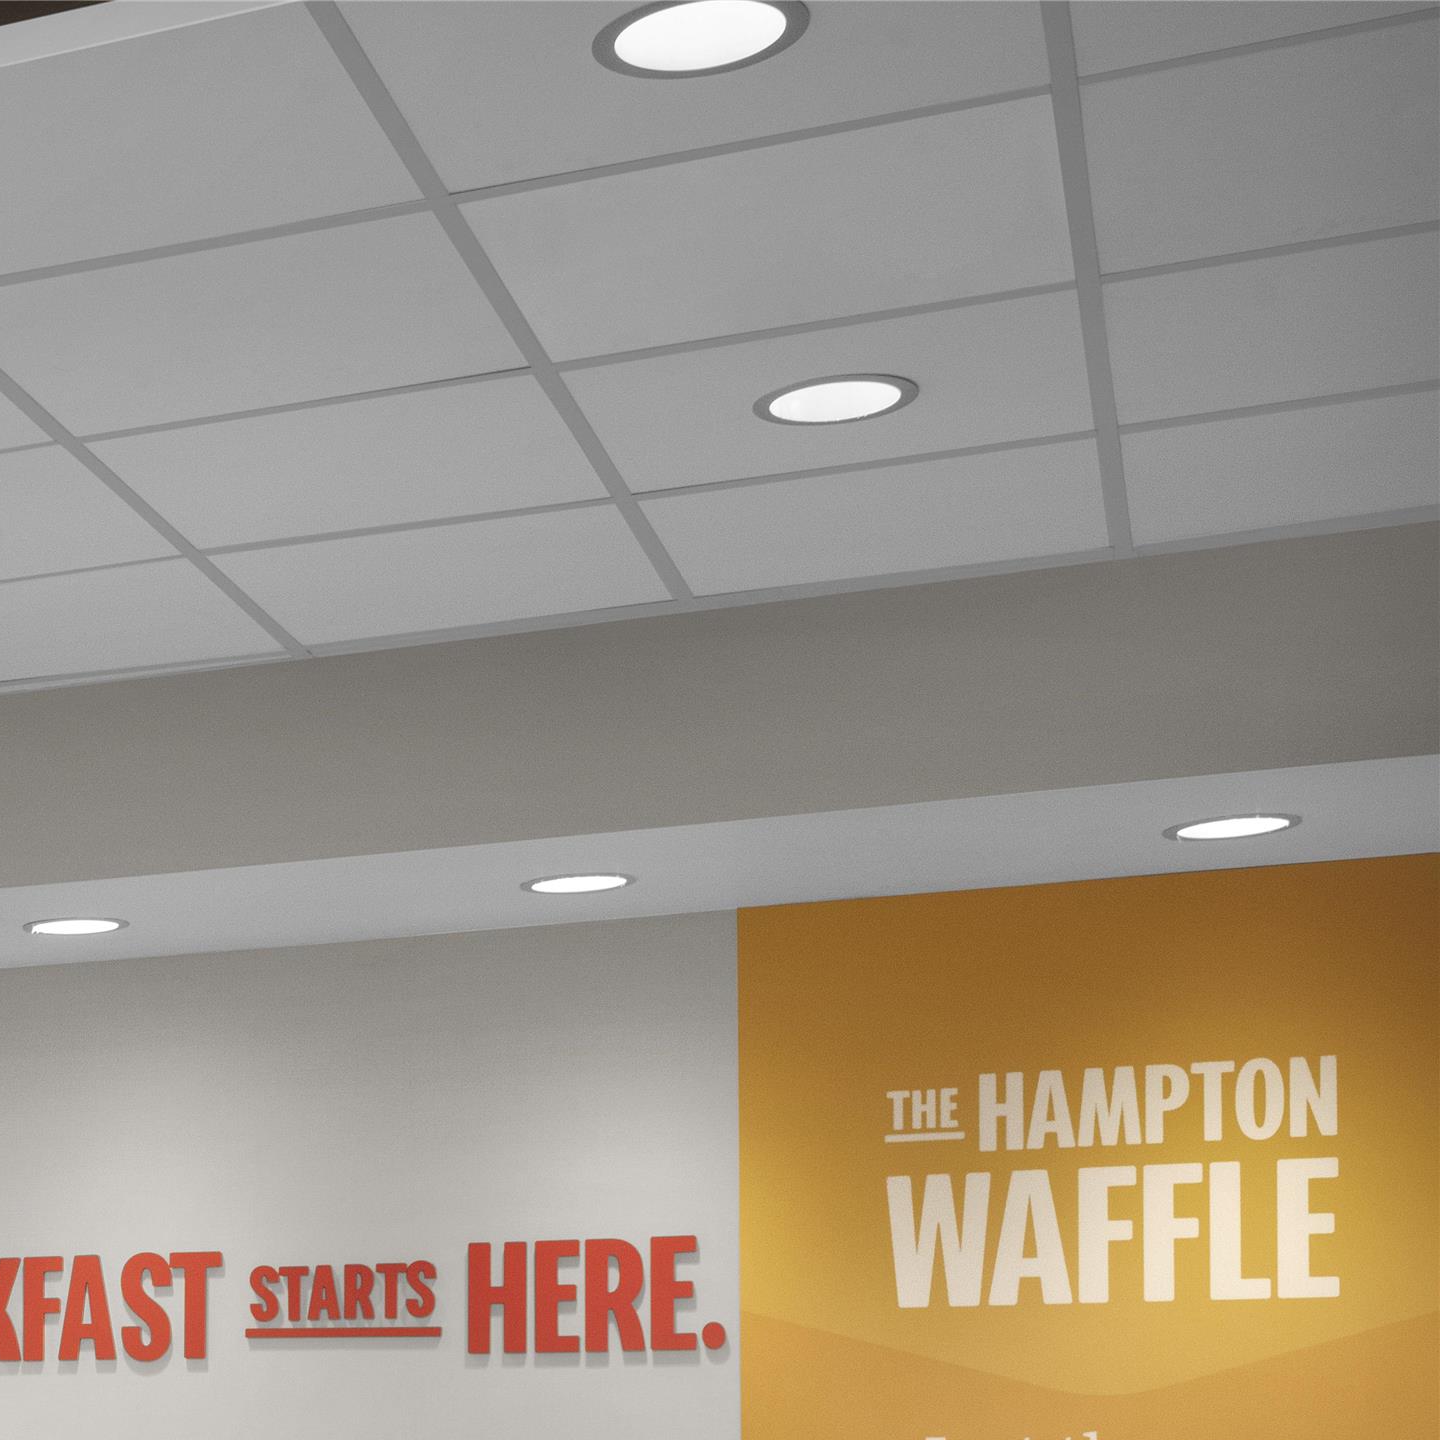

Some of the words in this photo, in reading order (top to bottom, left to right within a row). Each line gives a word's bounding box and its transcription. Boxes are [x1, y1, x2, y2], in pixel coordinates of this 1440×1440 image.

[886, 1087, 960, 1131] THE
[978, 1055, 1338, 1152] HAMPTON
[886, 1157, 1340, 1309] WAFFLE
[249, 1259, 438, 1323] STARTS
[467, 1235, 727, 1354] HERE.
